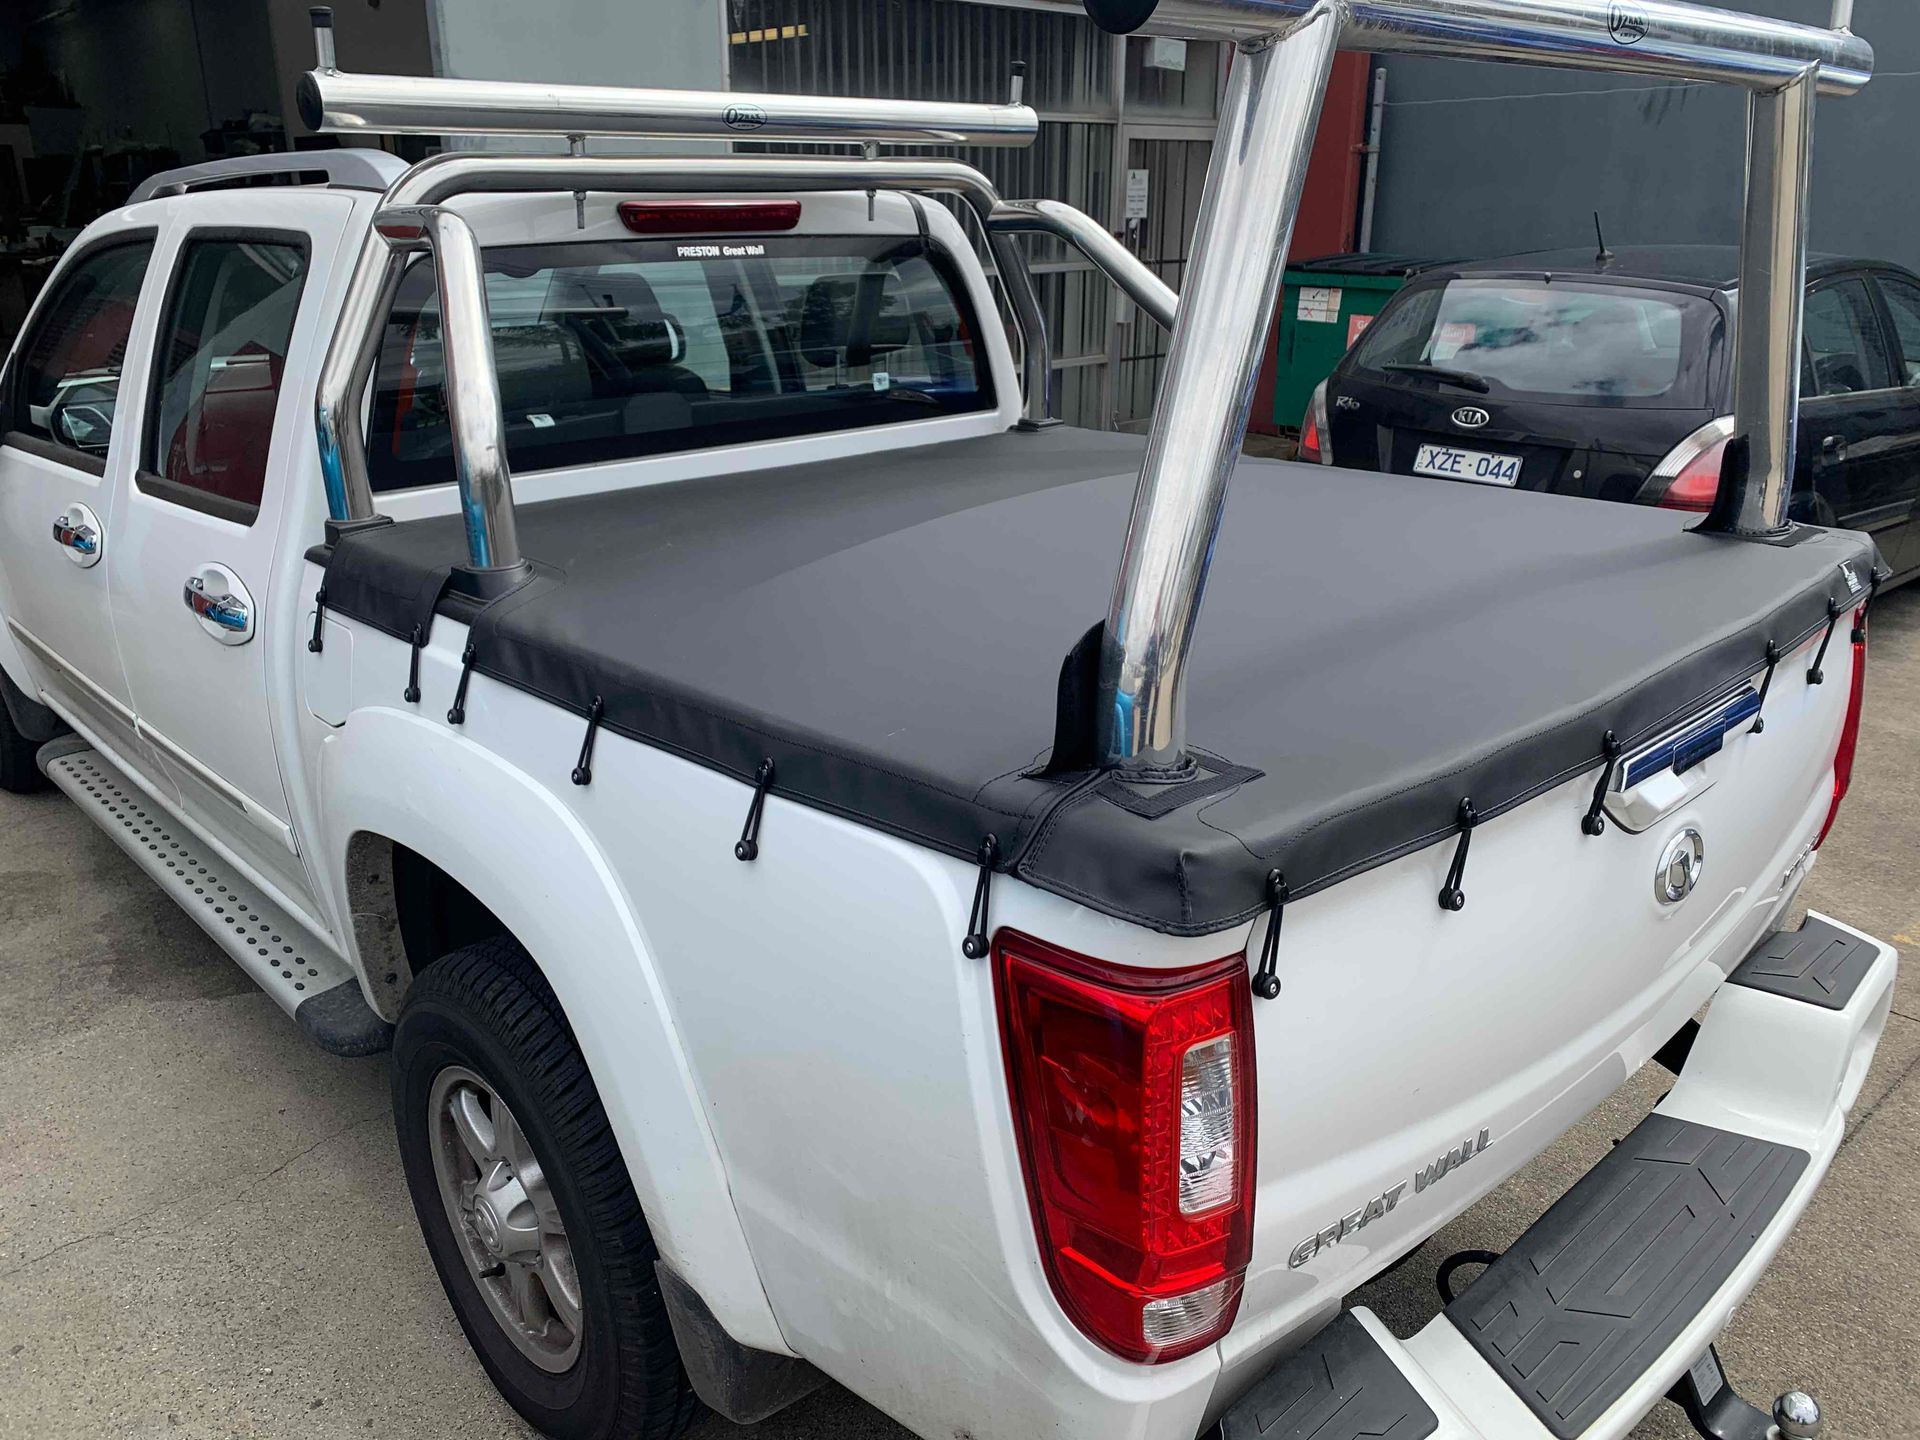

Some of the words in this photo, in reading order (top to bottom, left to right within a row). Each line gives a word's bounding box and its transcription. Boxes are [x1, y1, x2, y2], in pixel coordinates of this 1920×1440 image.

[677, 246, 720, 257] PRESTON
[723, 246, 746, 256] Great
[746, 245, 764, 255] Wall
[1457, 409, 1482, 424] KIA
[1289, 1179, 1407, 1269] GREAT
[1415, 1127, 1494, 1193] WALL
